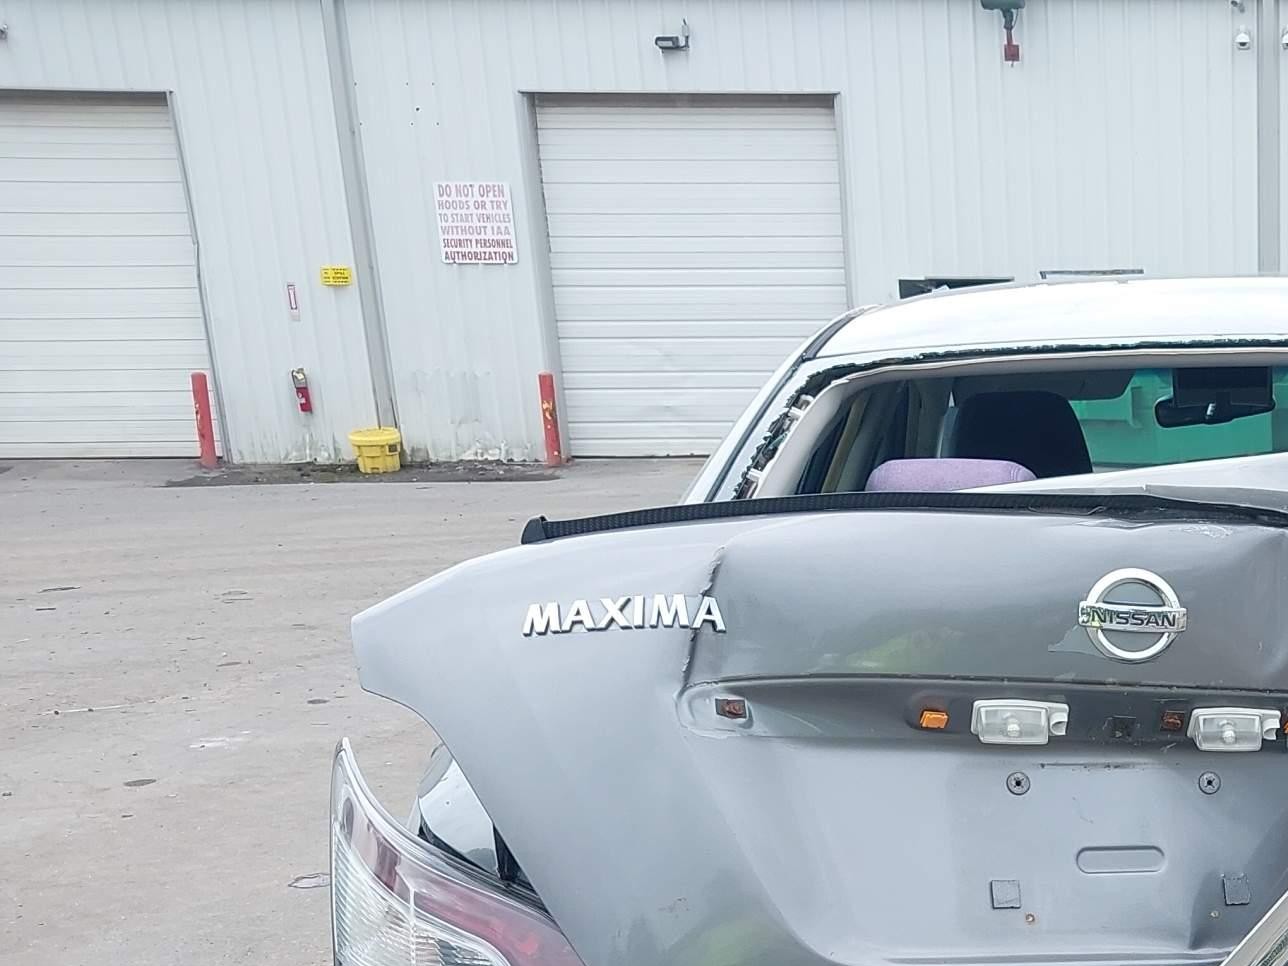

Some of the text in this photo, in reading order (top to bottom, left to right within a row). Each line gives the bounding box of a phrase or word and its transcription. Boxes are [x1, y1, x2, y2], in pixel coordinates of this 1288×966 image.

[437, 184, 505, 198] DO NOT OPEN
[437, 200, 508, 210] HOODS OR TRY
[438, 213, 511, 224] TO START VEHICLES
[440, 225, 511, 236] WITHOUT IAA
[443, 238, 513, 249] SECURITY PERSONNEL
[444, 251, 514, 261] AUTHORIZATION
[522, 593, 727, 637] MAXIMA
[1091, 608, 1177, 628] NISSAN
